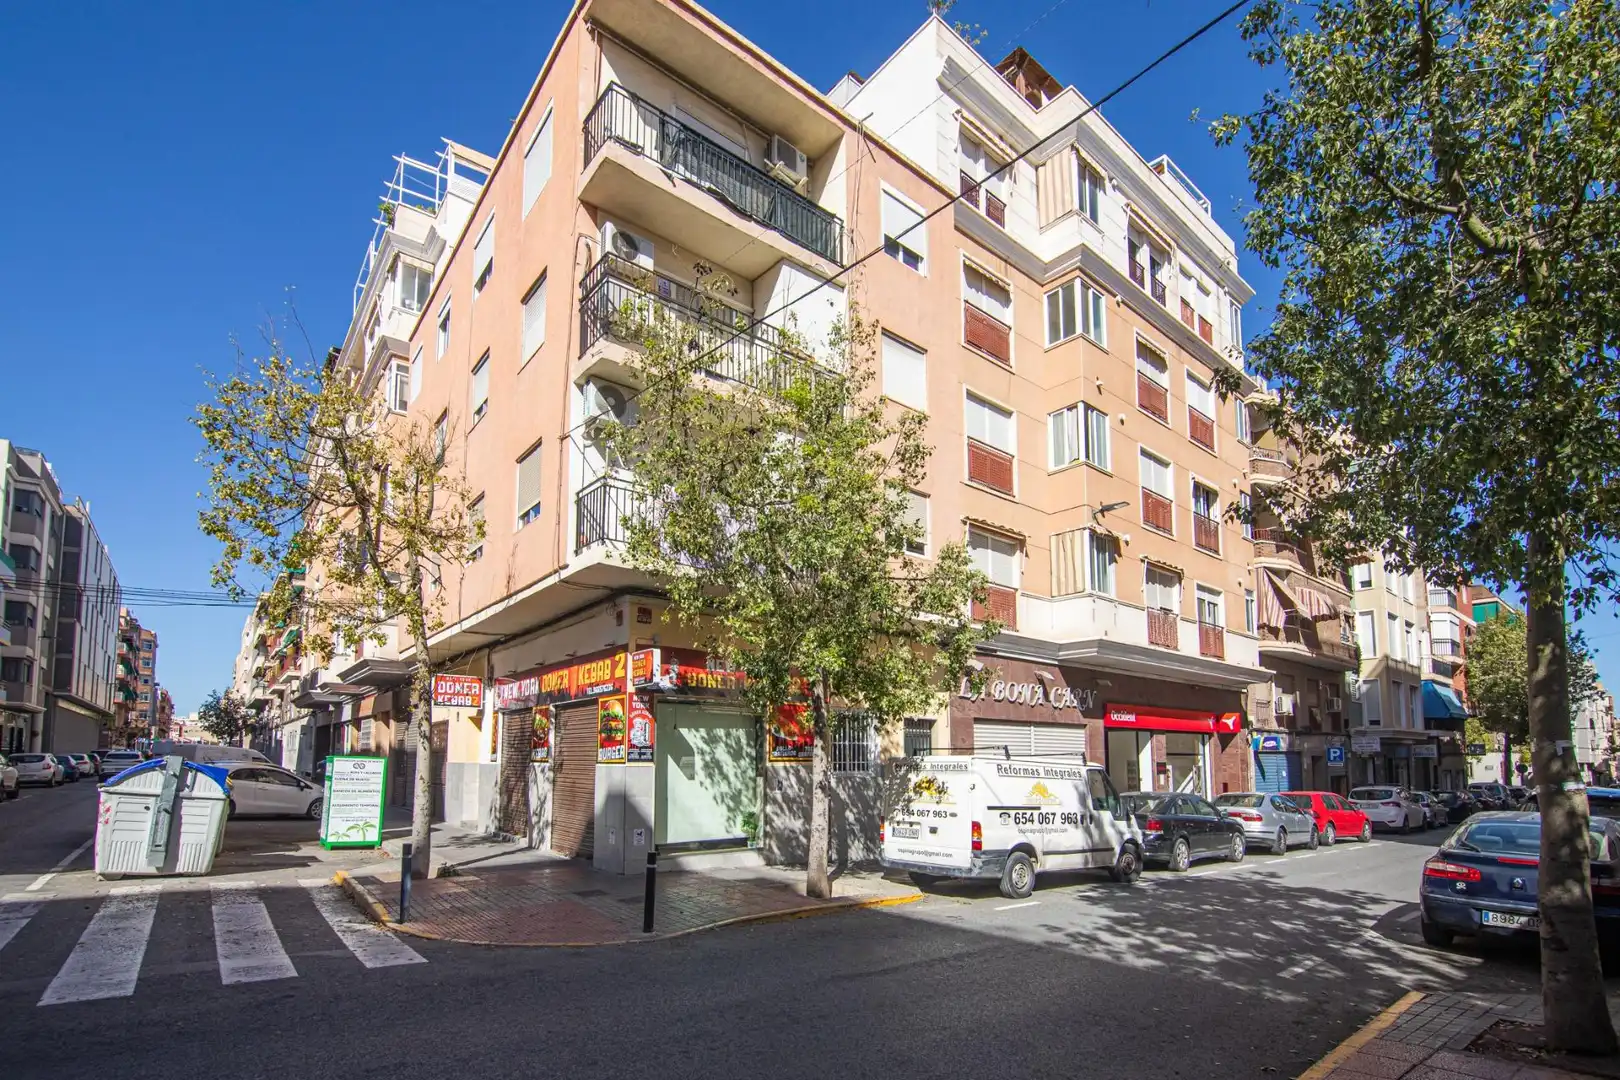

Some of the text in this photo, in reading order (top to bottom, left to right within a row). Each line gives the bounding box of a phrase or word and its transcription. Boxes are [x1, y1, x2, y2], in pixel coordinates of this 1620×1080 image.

[578, 659, 611, 685] KEBAB
[614, 653, 625, 678] 2
[437, 695, 472, 706] KEBAB
[991, 680, 1045, 707] BONA
[1050, 686, 1096, 711] CARN
[1110, 710, 1136, 722] Occident
[599, 745, 625, 760] BURGER
[1330, 748, 1340, 760] P
[930, 762, 968, 772] Integrales
[996, 763, 1082, 779] Reformas Integrales
[901, 808, 948, 818] 654 067 963
[1014, 812, 1078, 825] 654 067 963
[1491, 913, 1522, 925] 8984
